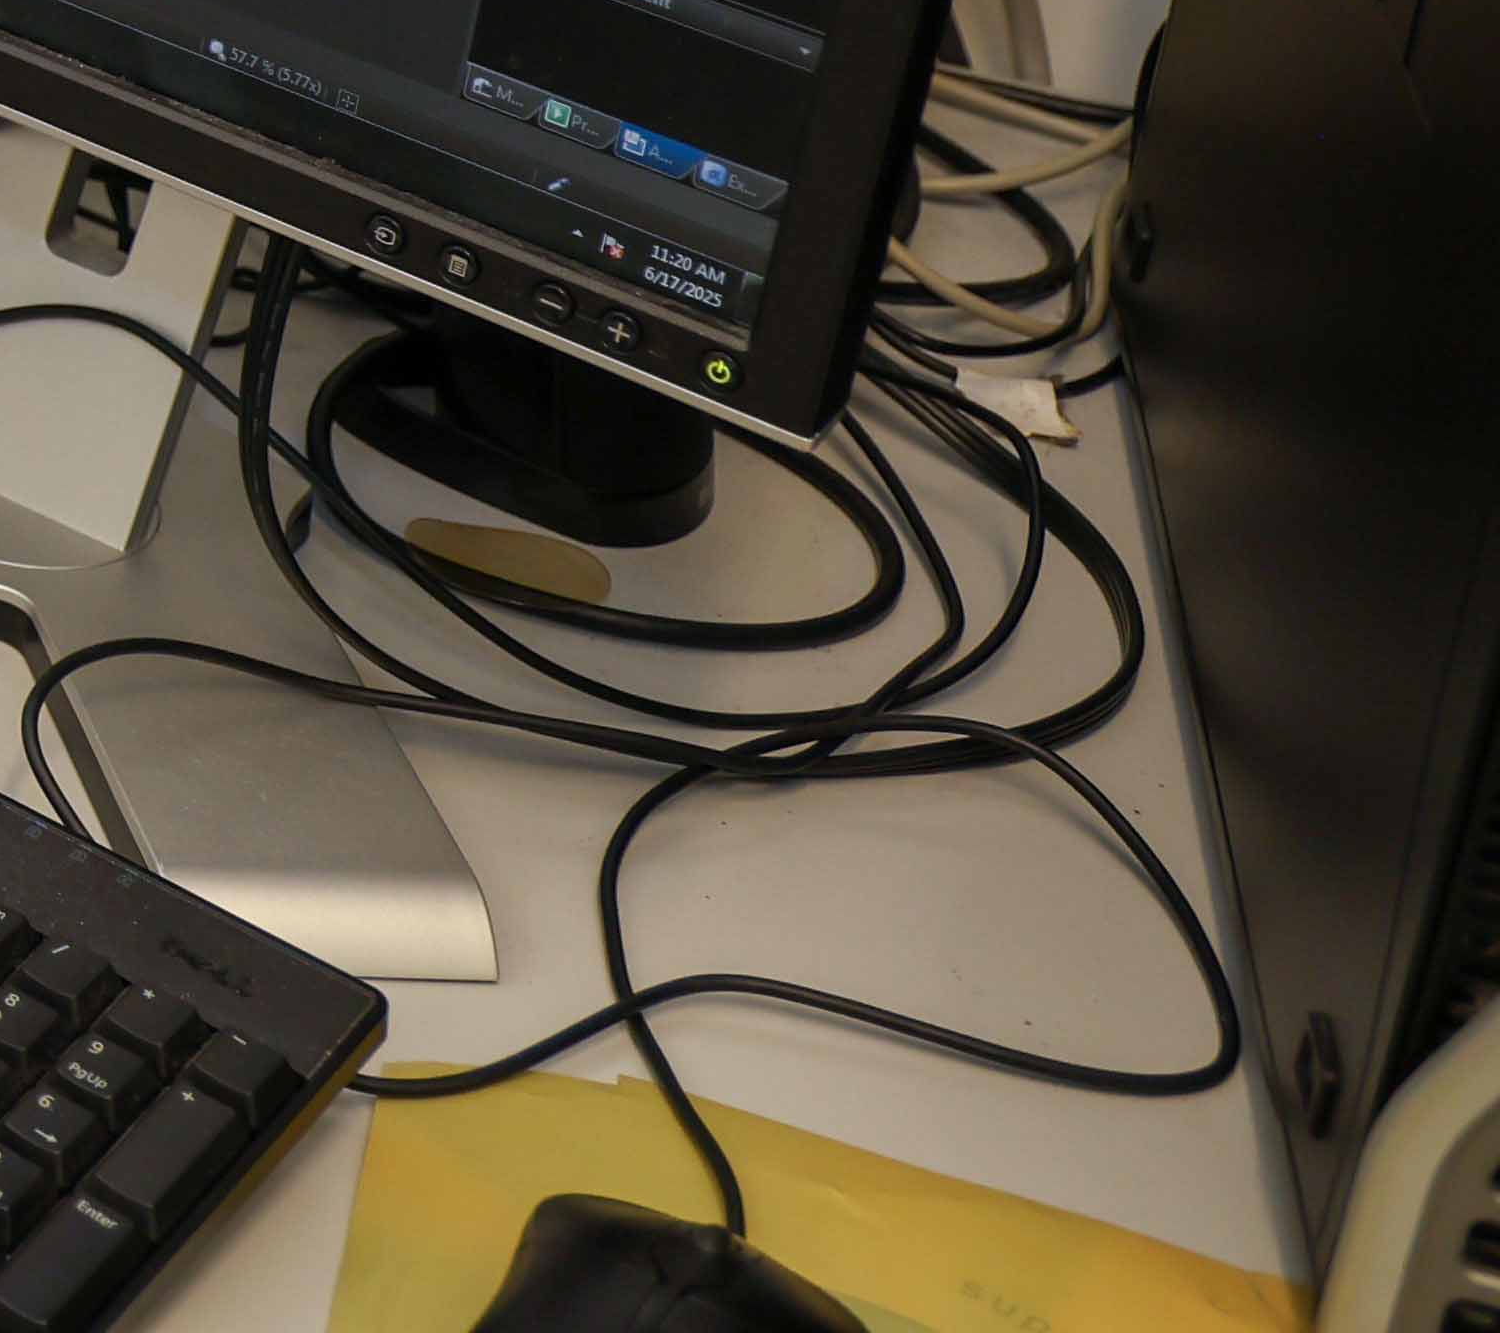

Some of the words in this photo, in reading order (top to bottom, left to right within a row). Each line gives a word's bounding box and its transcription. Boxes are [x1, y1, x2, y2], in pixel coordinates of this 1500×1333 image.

[229, 44, 261, 72] 57.7
[261, 59, 275, 76] %
[276, 60, 324, 98] (5.77x)
[650, 243, 693, 273] 11:20
[695, 262, 726, 286] AM
[643, 265, 725, 310] 6/17/2025
[4, 992, 21, 1008] 8
[87, 1040, 104, 1055] 9
[67, 1060, 109, 1091] PgUp
[36, 1093, 55, 1110] 6
[75, 1197, 120, 1231] Enter
